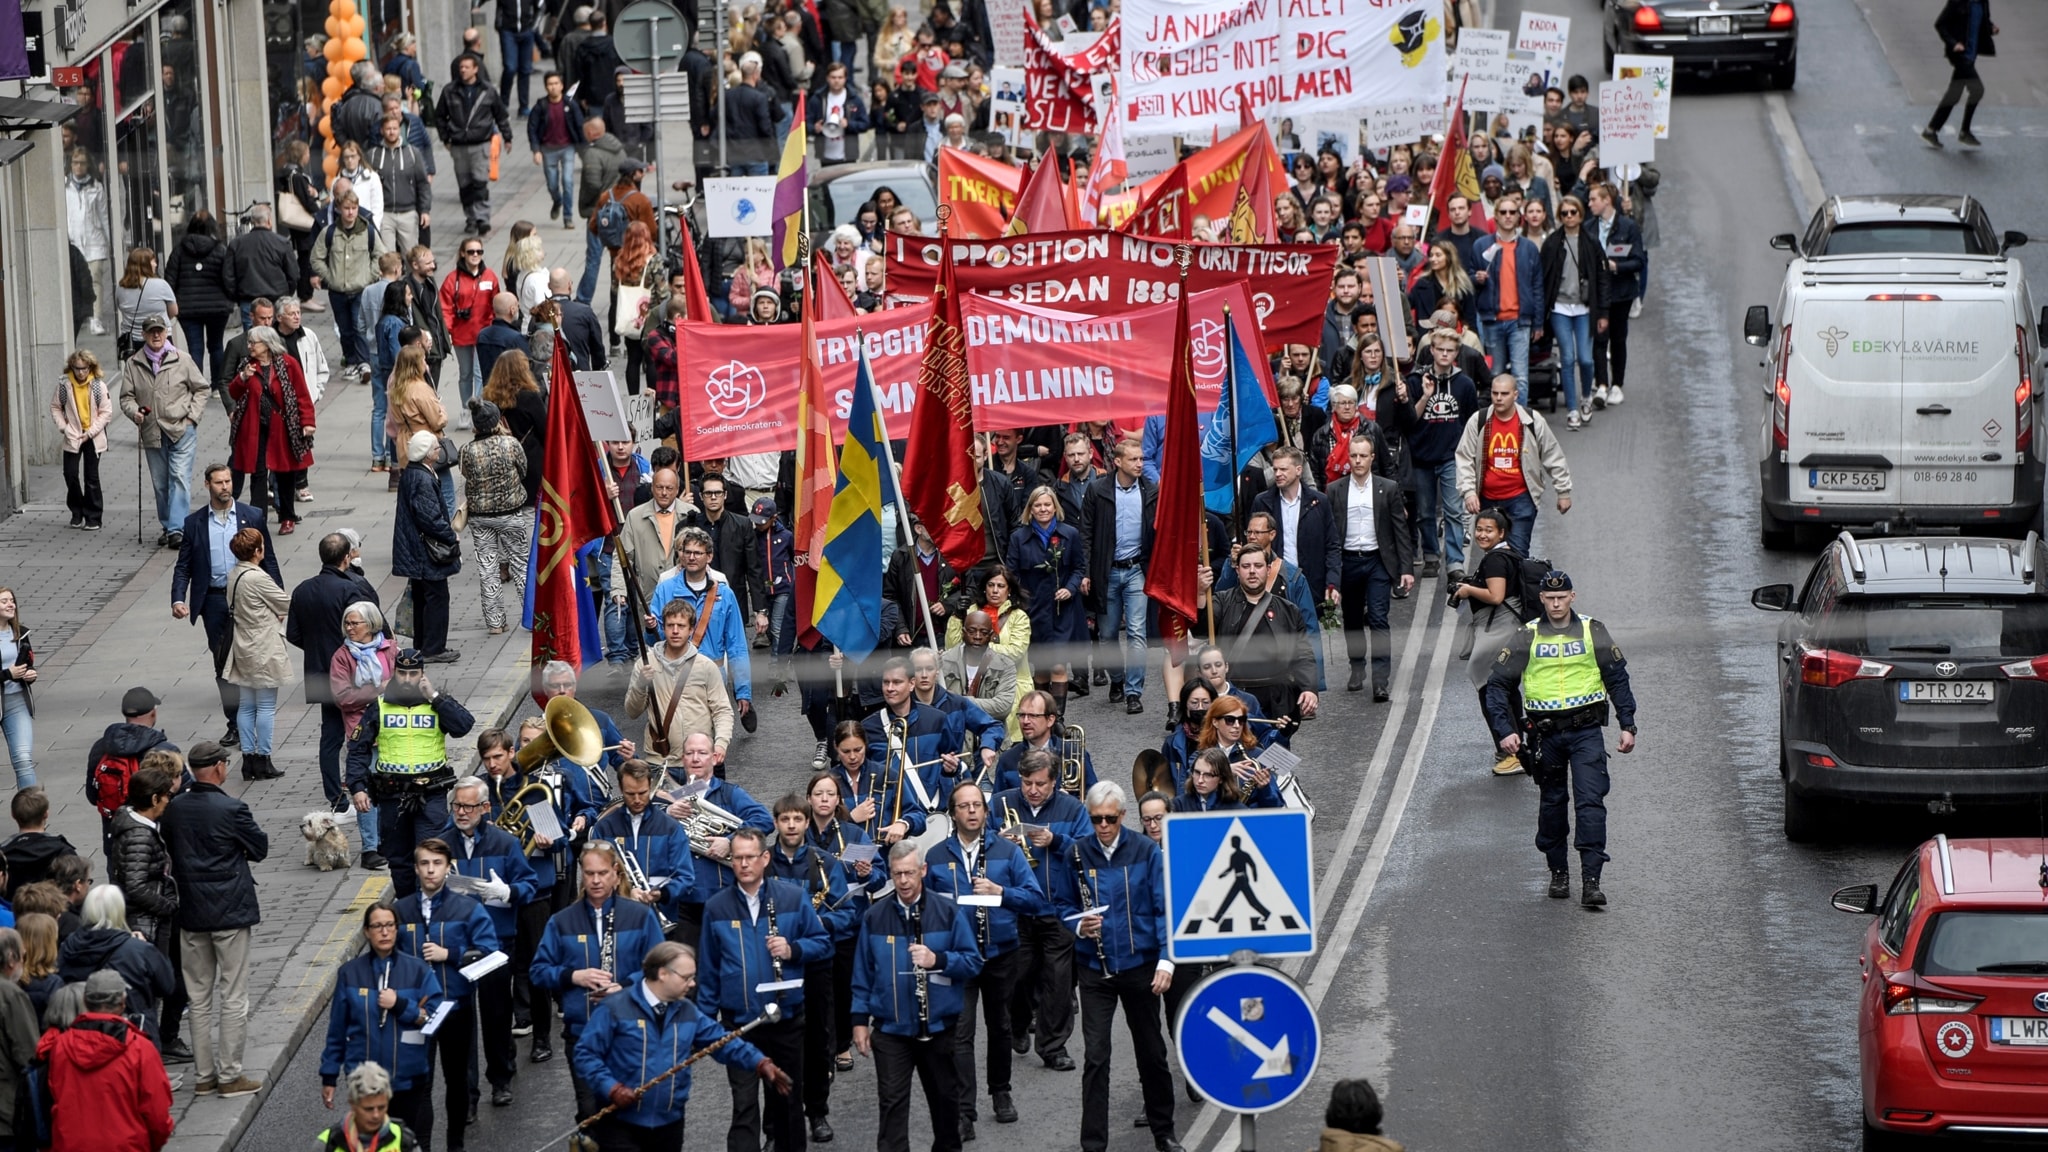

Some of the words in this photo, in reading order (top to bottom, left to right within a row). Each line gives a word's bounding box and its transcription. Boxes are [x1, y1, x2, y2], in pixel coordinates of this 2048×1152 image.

[1297, 30, 1347, 60] DIG
[1520, 39, 1564, 53] KLIMATET
[948, 175, 1015, 209] THERE
[921, 233, 1109, 268] OPPOSITION
[1122, 237, 1196, 267] MO
[815, 322, 929, 366] TRYGGH
[1425, 392, 1459, 412] AUTHENTICS
[696, 420, 782, 435] Socialdemokraterna
[1914, 453, 1978, 463] www.edekyl.se
[1821, 472, 1848, 485] CKP
[1852, 473, 1879, 486] 565
[1913, 471, 1947, 482] 018-69
[1950, 471, 1962, 482] 28
[1964, 471, 1978, 482] 40
[1539, 641, 1582, 657] POLIS
[1915, 683, 1948, 698] PTR
[1953, 683, 1987, 698] 024
[387, 715, 432, 728] POLIS
[2010, 1019, 2048, 1038] LWR
